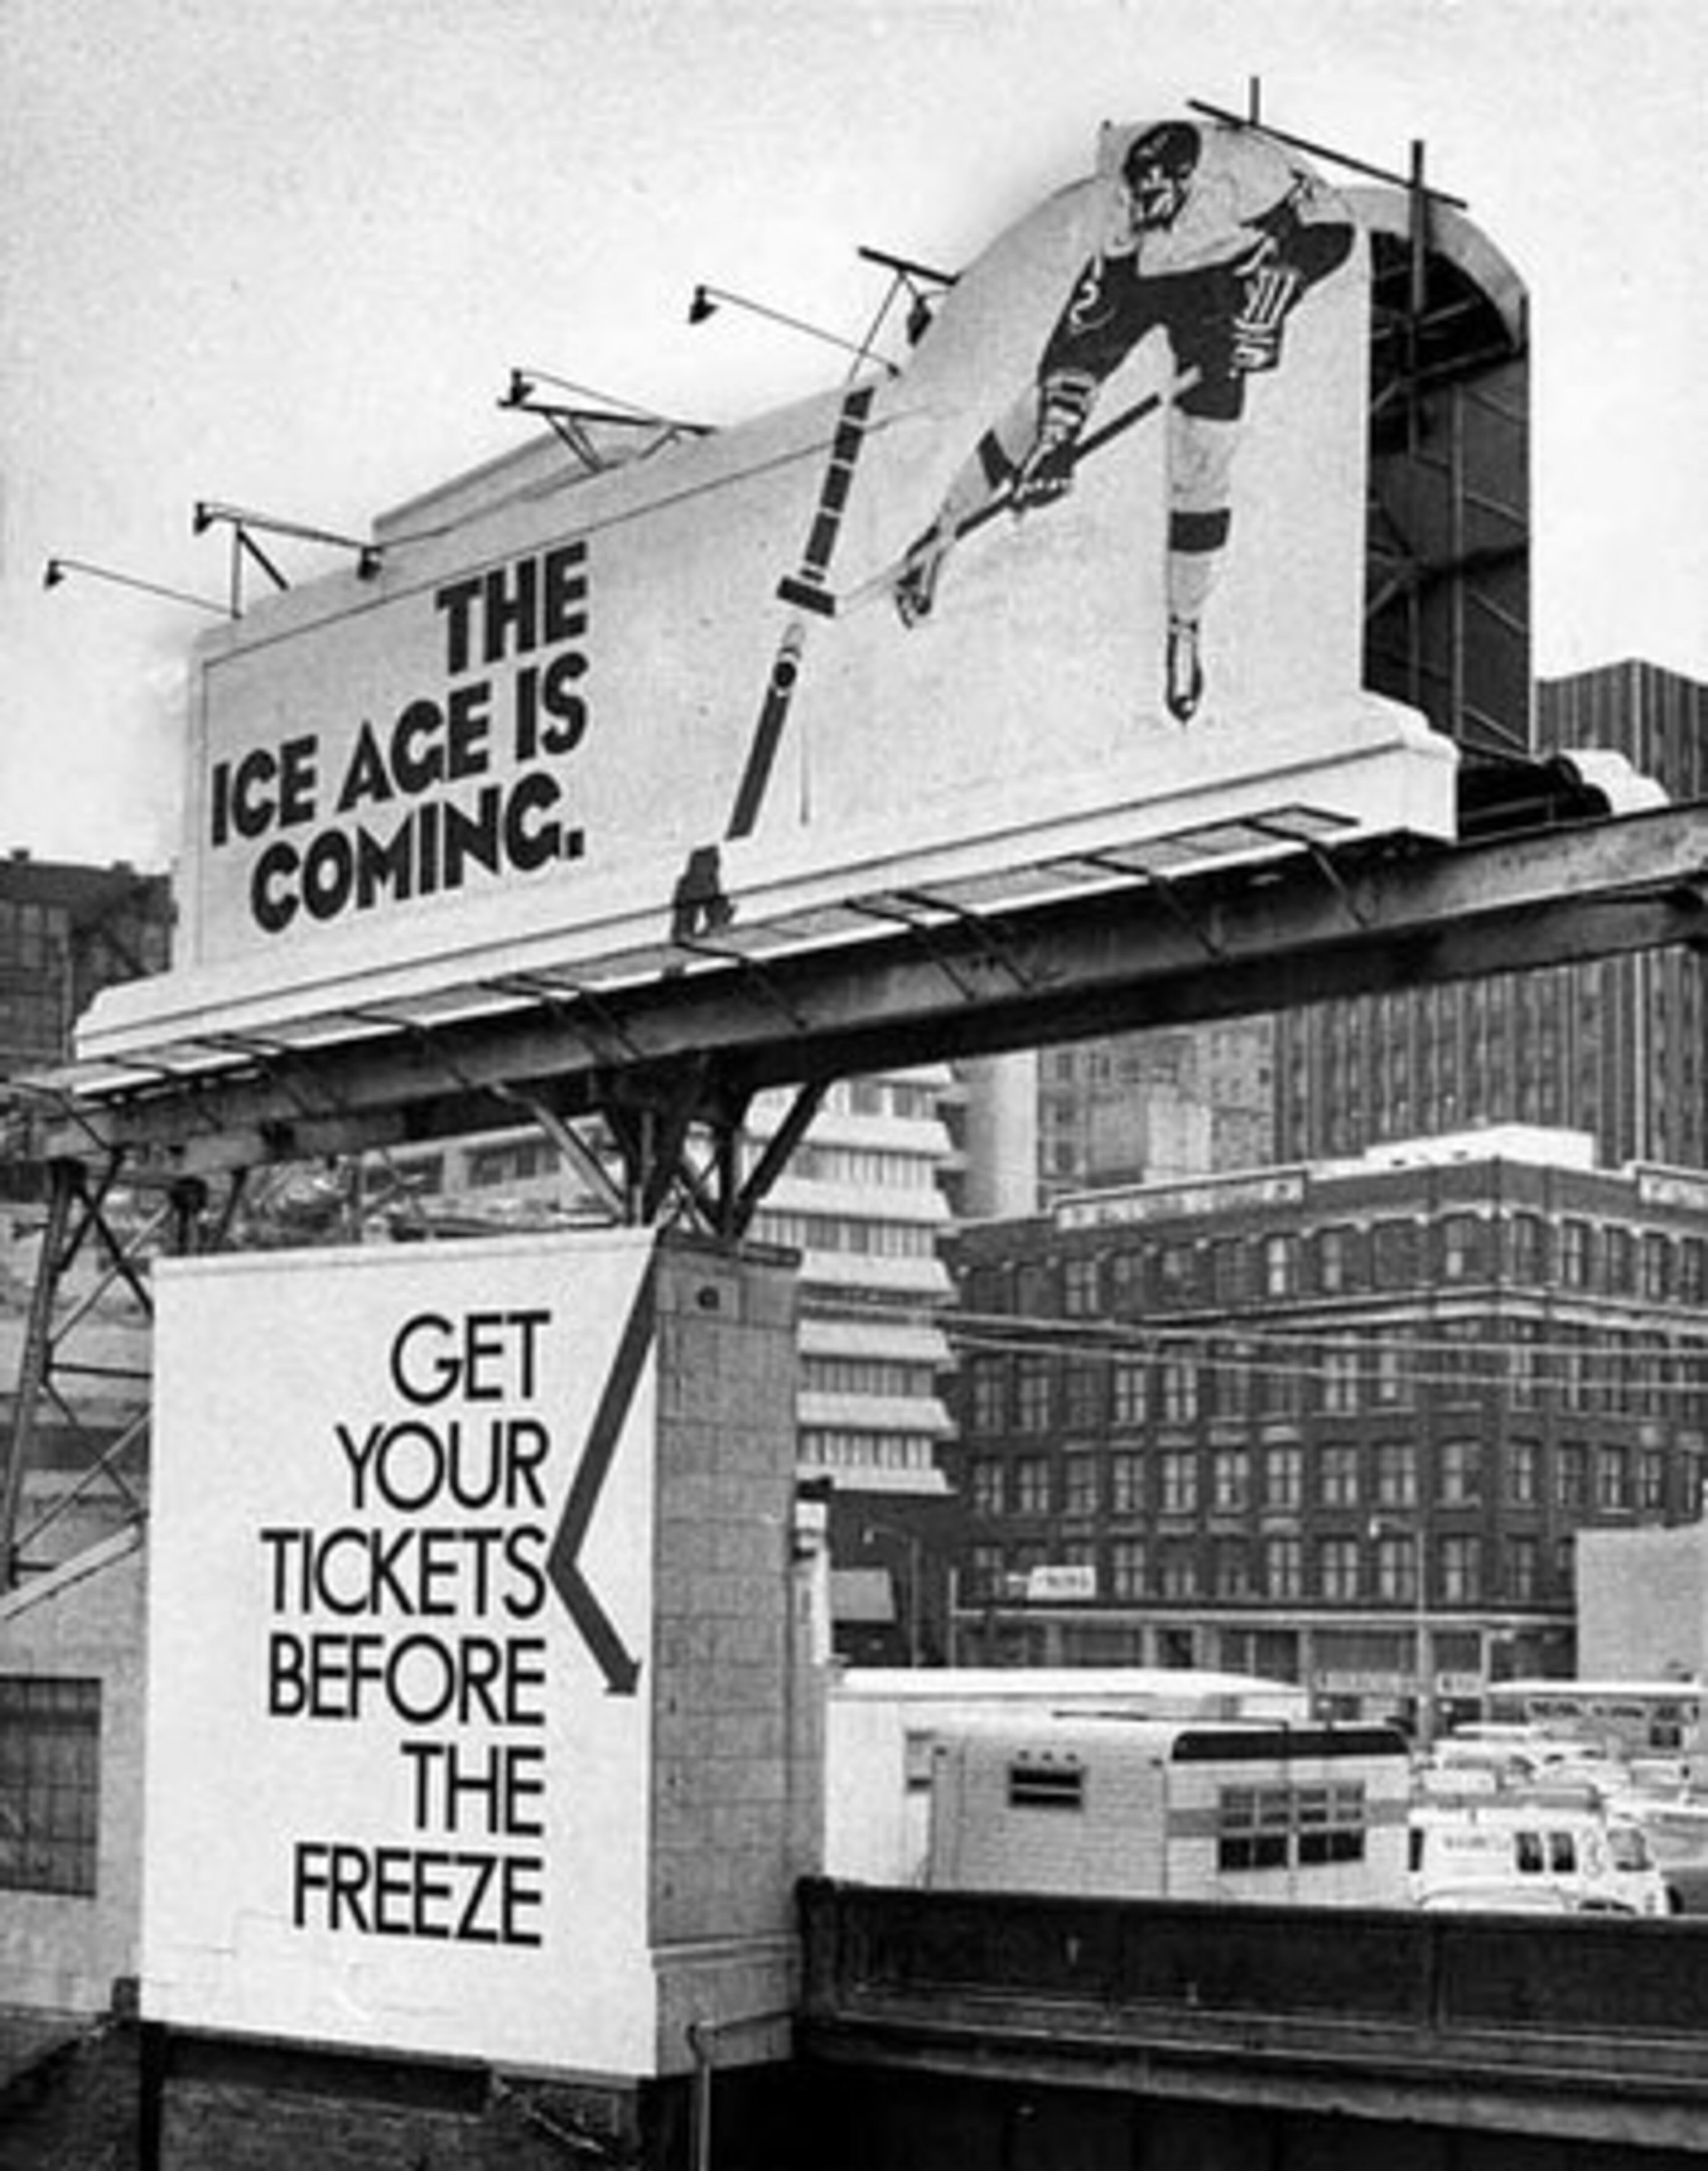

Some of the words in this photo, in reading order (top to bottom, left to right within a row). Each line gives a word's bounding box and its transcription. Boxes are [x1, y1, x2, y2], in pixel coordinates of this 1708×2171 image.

[435, 540, 588, 676] THE
[211, 734, 318, 848] ICE
[336, 680, 491, 814] AGE
[515, 651, 589, 763] IS
[250, 772, 584, 934] COMING.
[391, 1310, 551, 1406] GET
[335, 1420, 549, 1512] YOUR
[260, 1525, 546, 1619] TICKETS
[269, 1632, 546, 1726] BEFORE
[401, 1742, 544, 1837] THE
[294, 1842, 543, 1947] FREEZE
